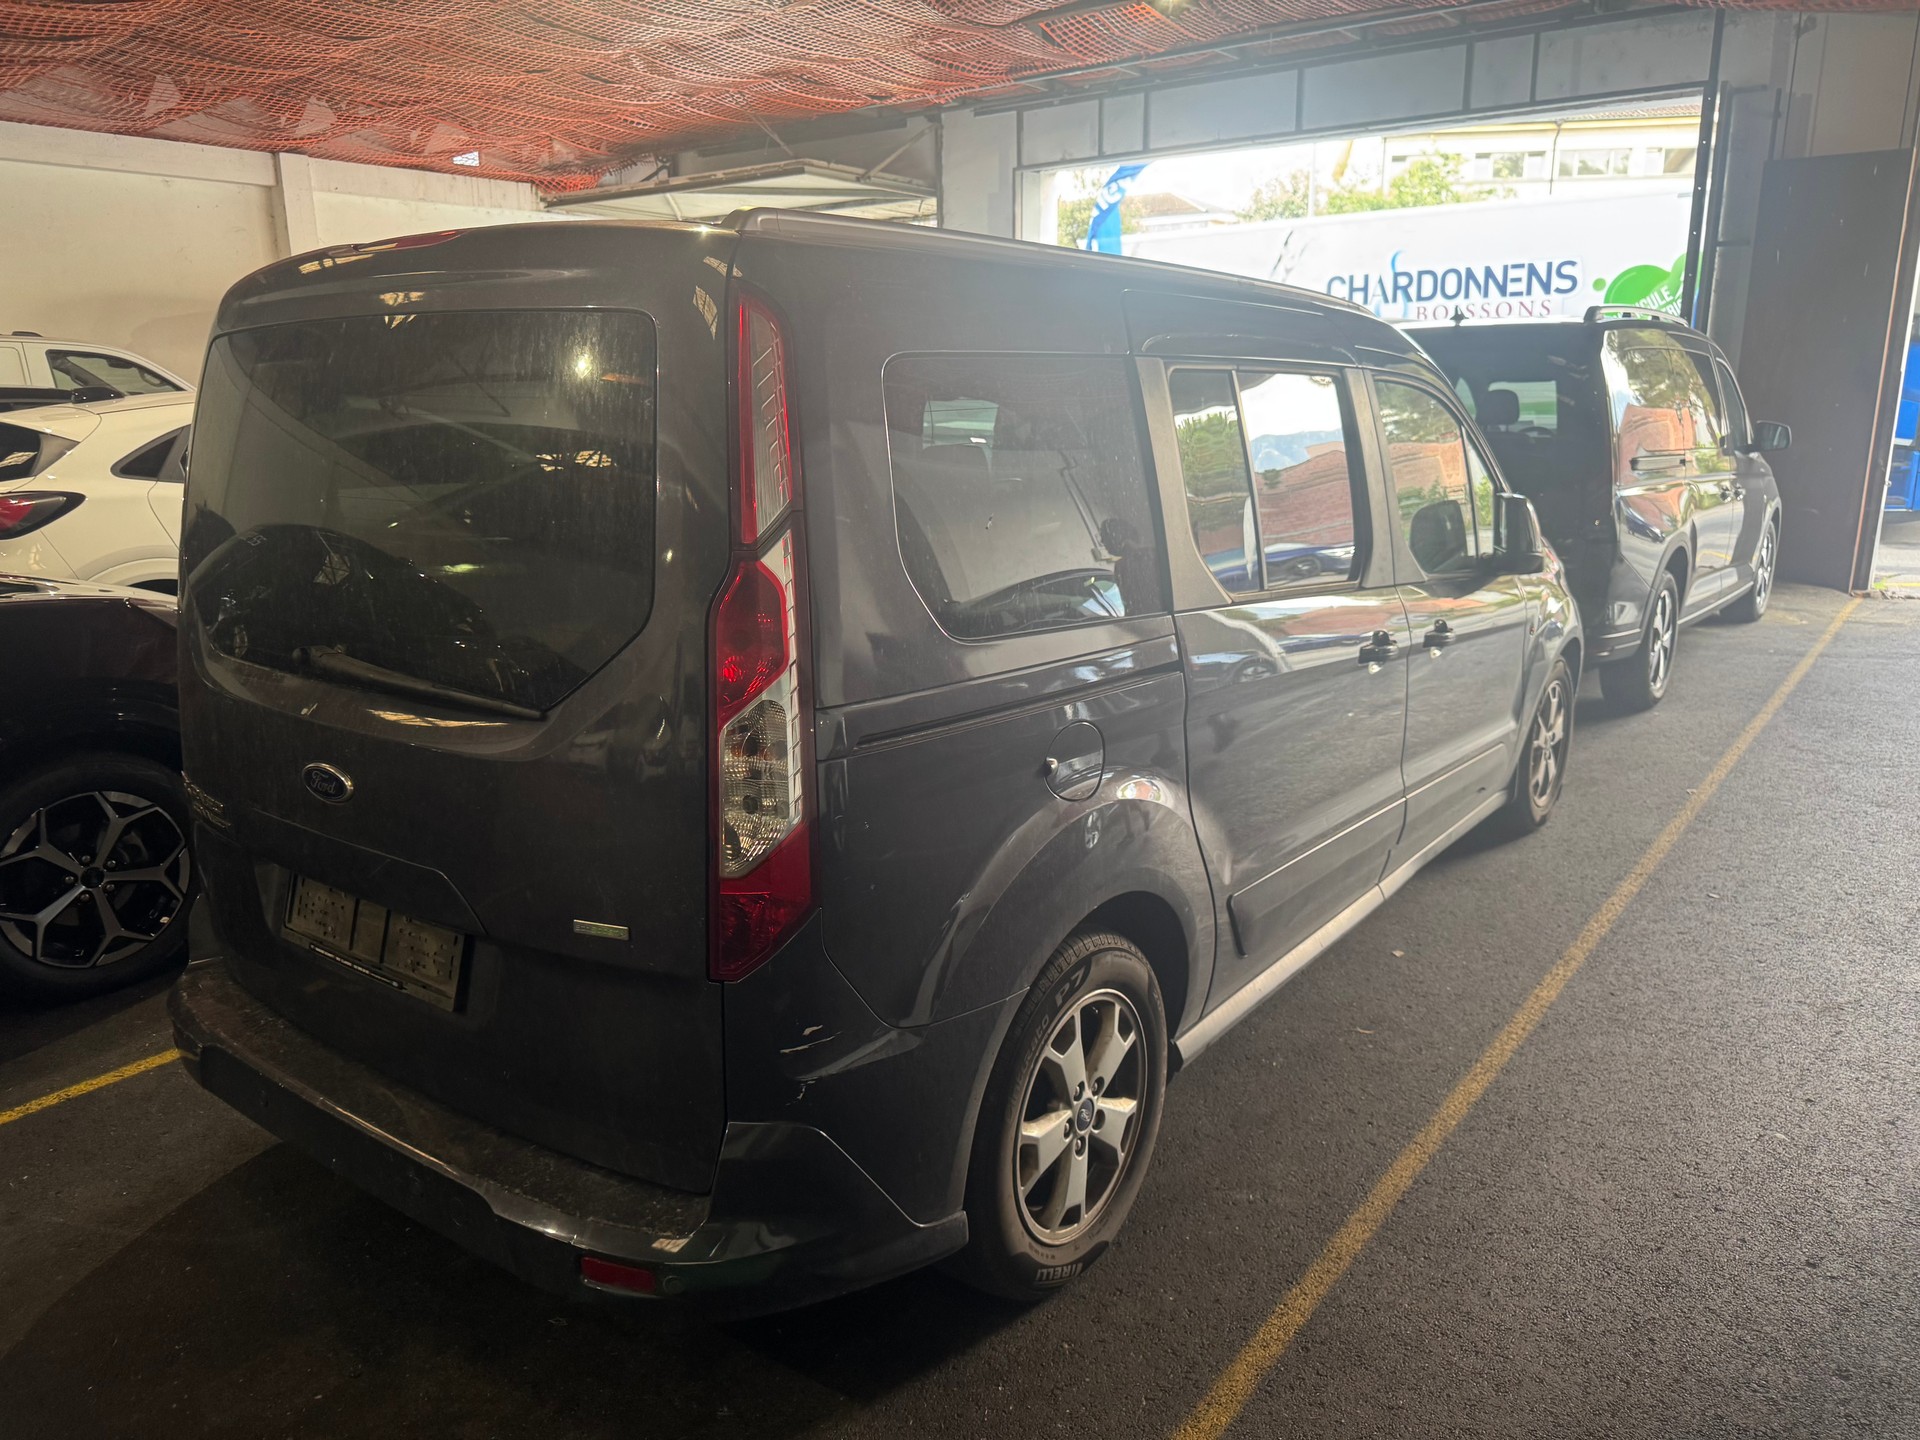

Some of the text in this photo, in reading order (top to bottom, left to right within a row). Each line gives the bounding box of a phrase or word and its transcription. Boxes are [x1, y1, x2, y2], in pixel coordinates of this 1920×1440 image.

[1326, 260, 1578, 305] CHARDONNENS
[1416, 299, 1551, 320] BOSSONS
[1055, 964, 1087, 1009] P7
[1034, 1262, 1083, 1286] PIRELLI
